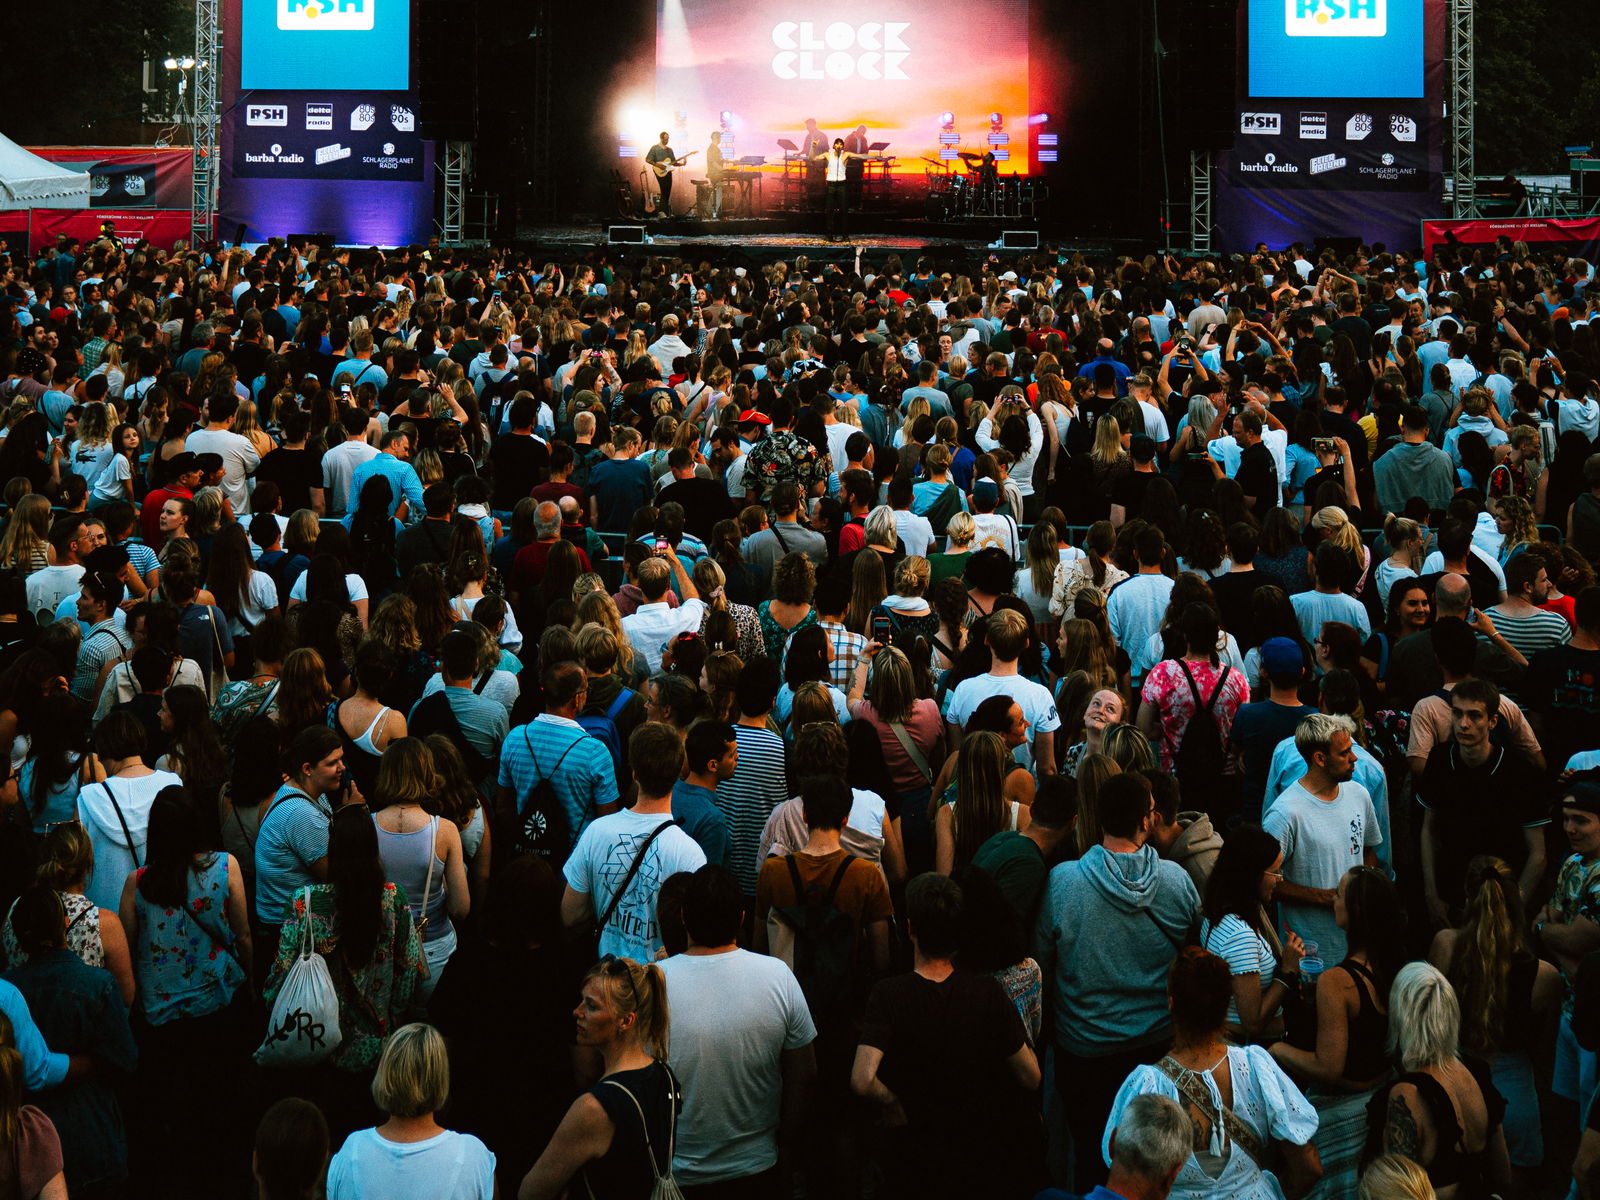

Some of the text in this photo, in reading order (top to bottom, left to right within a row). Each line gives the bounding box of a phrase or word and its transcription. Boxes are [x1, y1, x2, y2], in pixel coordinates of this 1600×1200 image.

[772, 21, 912, 50] CLOCK
[772, 51, 912, 80] CLOCK
[307, 106, 331, 114] delta
[359, 104, 375, 113] 80s
[391, 104, 409, 114] 90s
[359, 113, 375, 122] 80s
[390, 114, 409, 123] 90s
[1354, 113, 1372, 123] 80s
[1389, 114, 1410, 124] 90s
[1354, 123, 1372, 132] 80s
[1389, 124, 1410, 134] 90s
[246, 153, 304, 163] barba radio
[362, 156, 414, 164] SCHLAGERPLANET
[1240, 162, 1298, 173] barba radio
[1359, 166, 1417, 174] SCHLAGERPLANET
